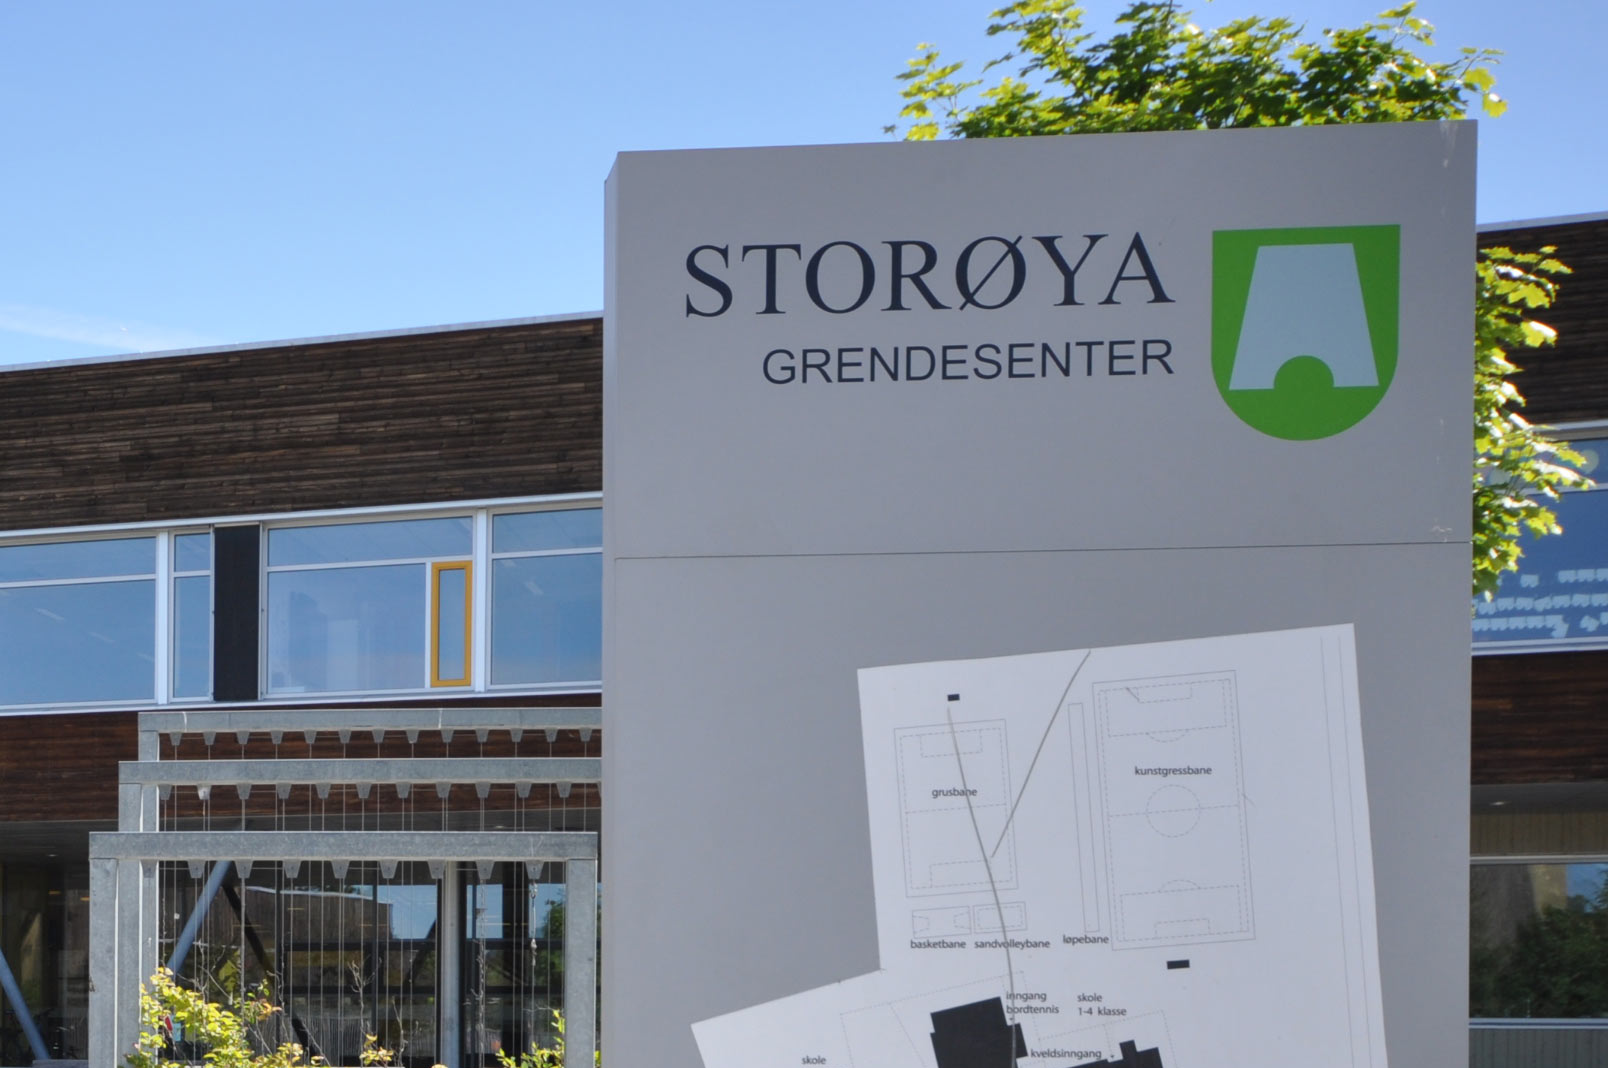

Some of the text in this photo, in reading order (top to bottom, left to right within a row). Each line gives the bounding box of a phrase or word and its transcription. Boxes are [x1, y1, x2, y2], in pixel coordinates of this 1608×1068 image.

[686, 231, 1176, 318] STORØYA
[763, 339, 1174, 384] GRENDESENTER
[1135, 765, 1212, 777] kunstgressbane
[932, 787, 977, 798] grusbane
[911, 938, 966, 949] basketbane
[974, 938, 1050, 950] sandvolleybane
[1063, 935, 1109, 946] løpebane
[1006, 991, 1047, 1002] inngang
[1077, 992, 1102, 1003] skole
[1006, 1004, 1059, 1015] bordtennis
[1078, 1006, 1127, 1016] 1-4 klasse
[1031, 1048, 1102, 1060] kveldsinngang
[802, 1055, 826, 1066] skole
